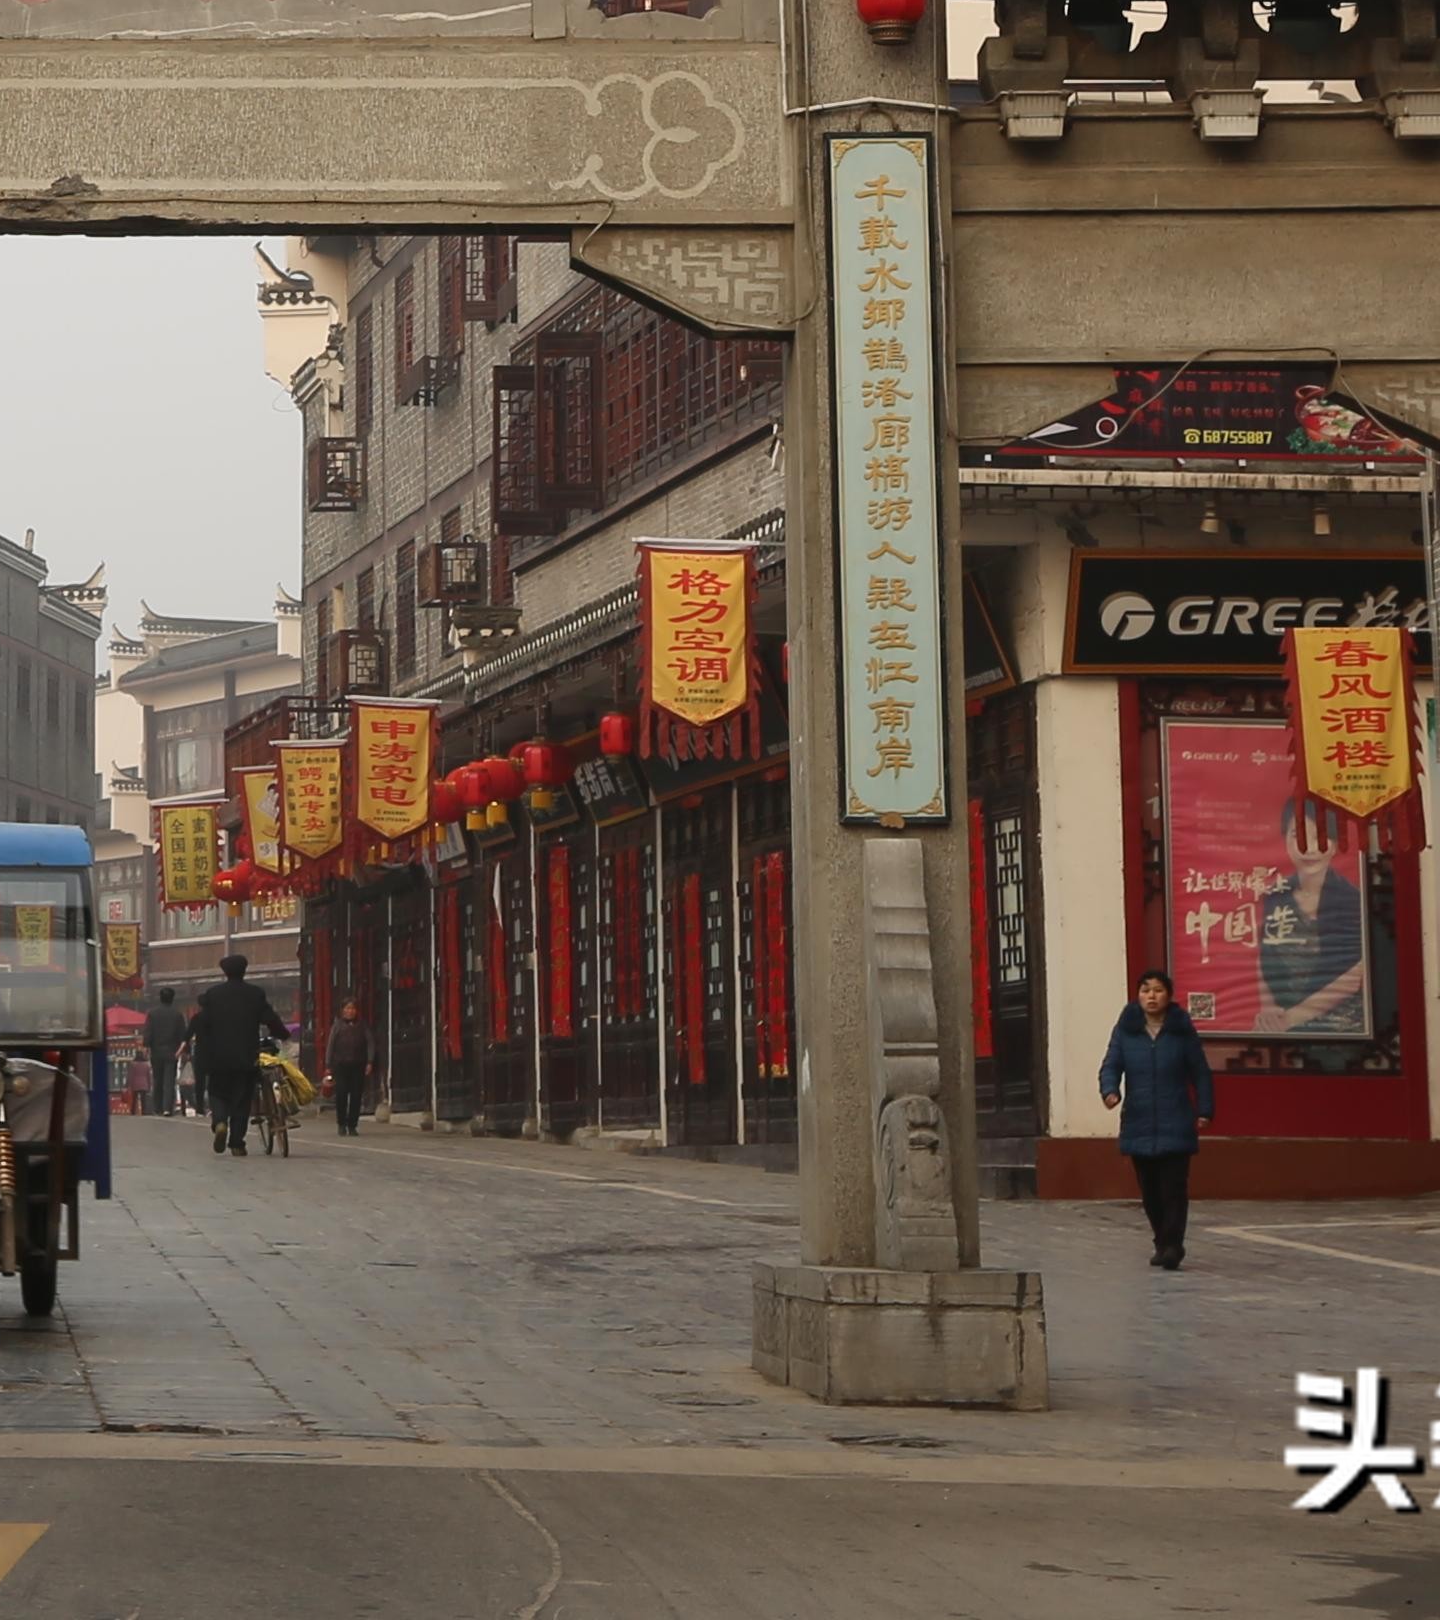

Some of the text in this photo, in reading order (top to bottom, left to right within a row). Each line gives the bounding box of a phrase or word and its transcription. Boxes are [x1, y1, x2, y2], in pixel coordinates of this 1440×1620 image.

[667, 568, 732, 683] 格力空调
[1168, 596, 1344, 636] GREE
[1313, 640, 1395, 769] 春风酒楼
[367, 720, 418, 806] 申涛家电
[171, 818, 188, 891] 全国连锁
[1185, 901, 1308, 964] 中国造
